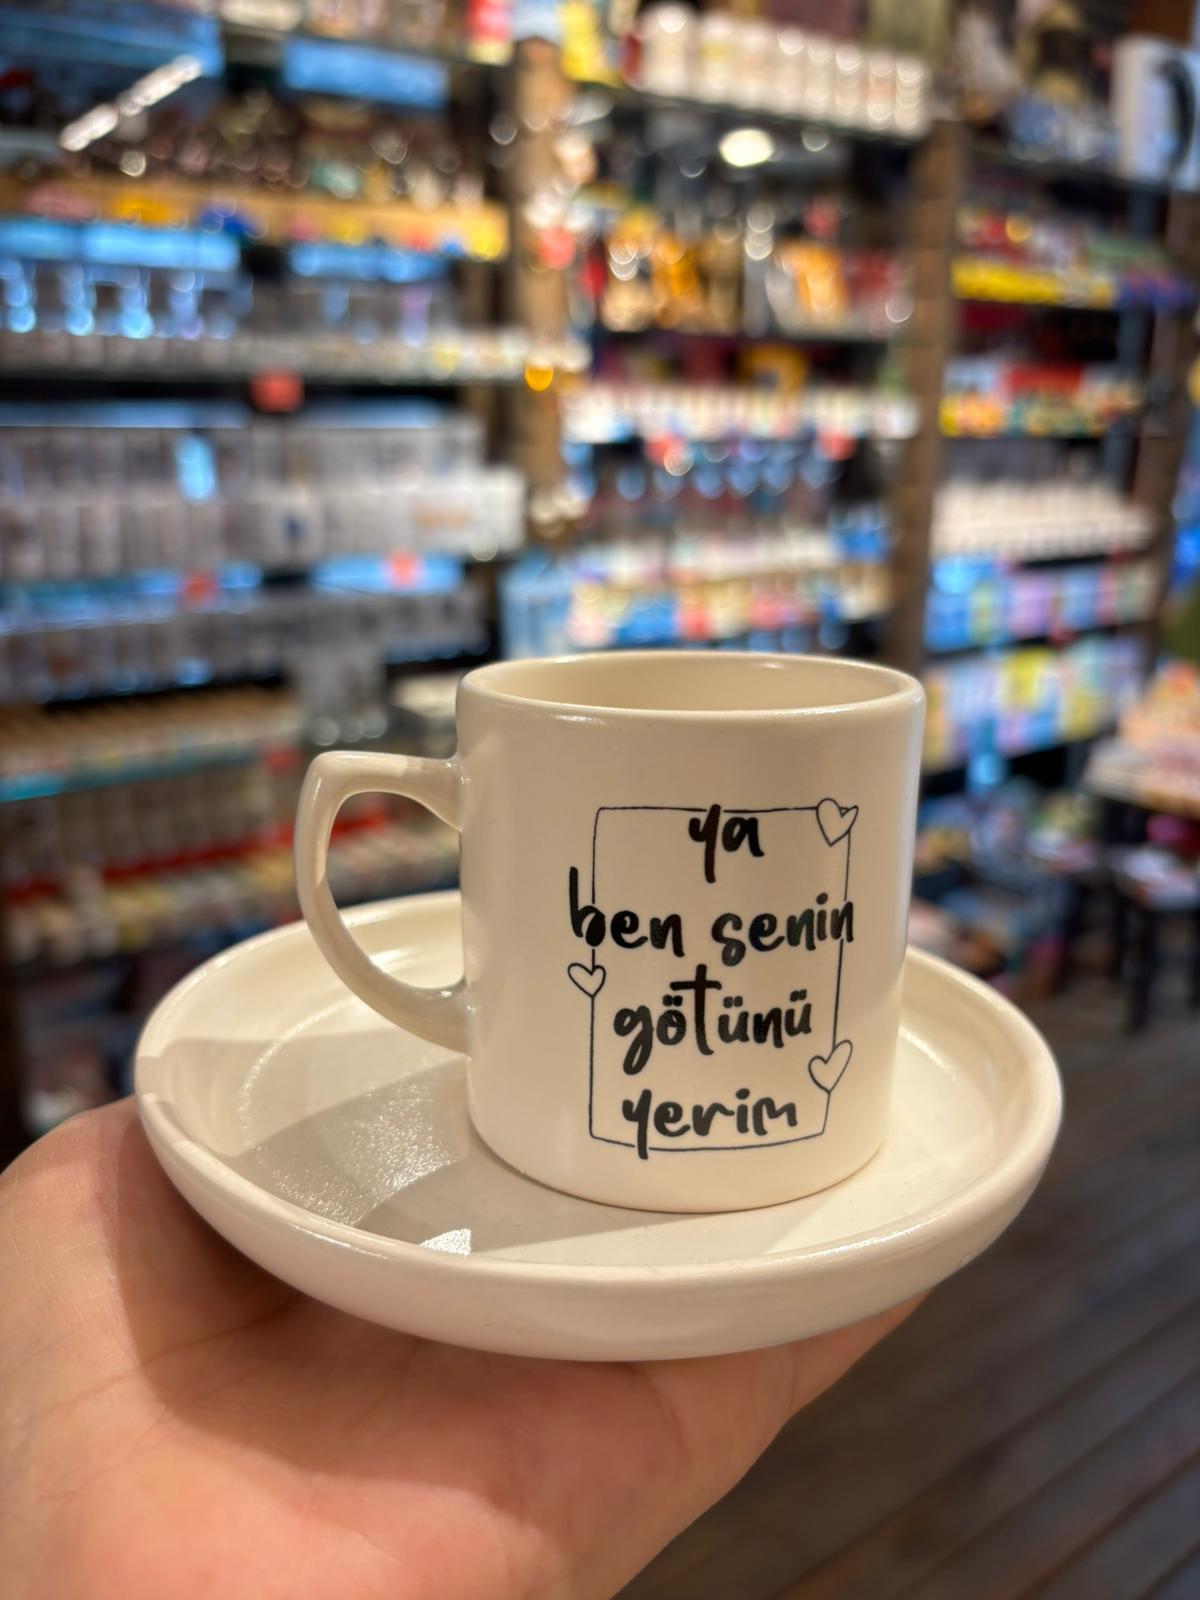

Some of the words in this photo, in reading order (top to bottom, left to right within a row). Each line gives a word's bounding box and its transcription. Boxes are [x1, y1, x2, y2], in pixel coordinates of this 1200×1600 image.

[689, 804, 764, 883] ya
[569, 867, 685, 957] ben
[711, 893, 854, 966] senin
[613, 964, 812, 1075] götünü
[622, 1088, 797, 1159] yerim
